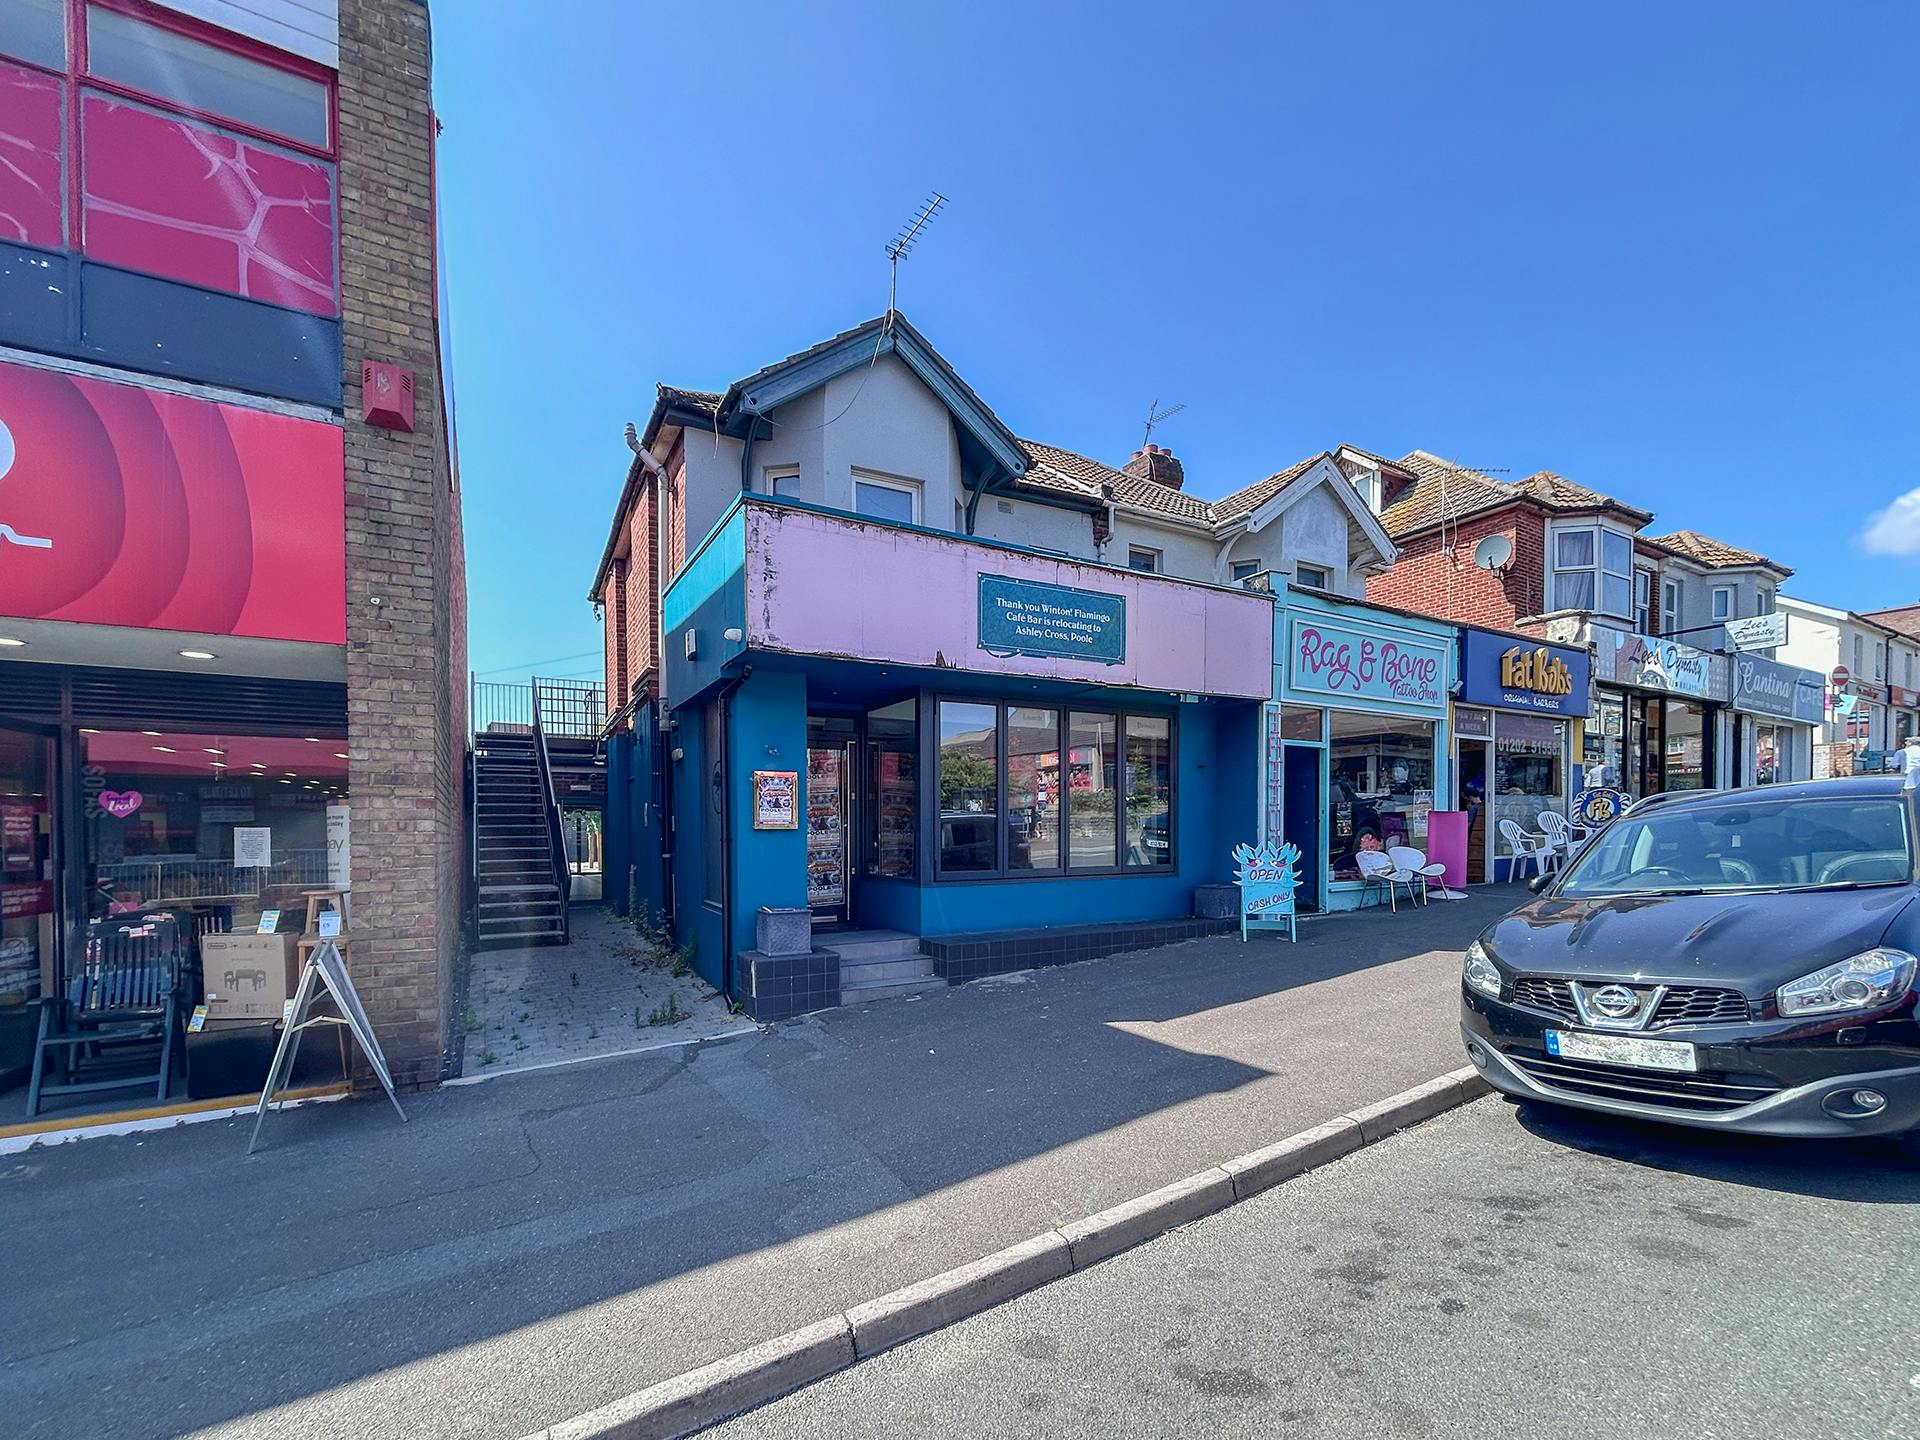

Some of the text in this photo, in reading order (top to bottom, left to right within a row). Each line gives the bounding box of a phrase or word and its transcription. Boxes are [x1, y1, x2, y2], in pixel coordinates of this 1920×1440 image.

[996, 597, 1110, 623] Thank you Winton! Flamingo
[1006, 611, 1101, 633] Café Bar is relocating to
[1740, 617, 1769, 631] Lee's
[1015, 626, 1093, 644] Ashley Cross, Poole
[1734, 628, 1776, 641] Dynasty
[1301, 628, 1360, 691] Rag
[1380, 643, 1437, 683] Bone
[1501, 646, 1574, 695] Fat Bob's
[1629, 638, 1702, 682] Lee's Dynasty
[1740, 661, 1792, 699] Cantina
[1390, 679, 1438, 704] Tattoo Shop
[1504, 694, 1560, 709] ORIGINAL BARBERS
[1498, 737, 1527, 753] 01202
[108, 797, 136, 812] Local
[1249, 868, 1284, 881] OPEN
[1247, 890, 1291, 912] CASH ONLY
